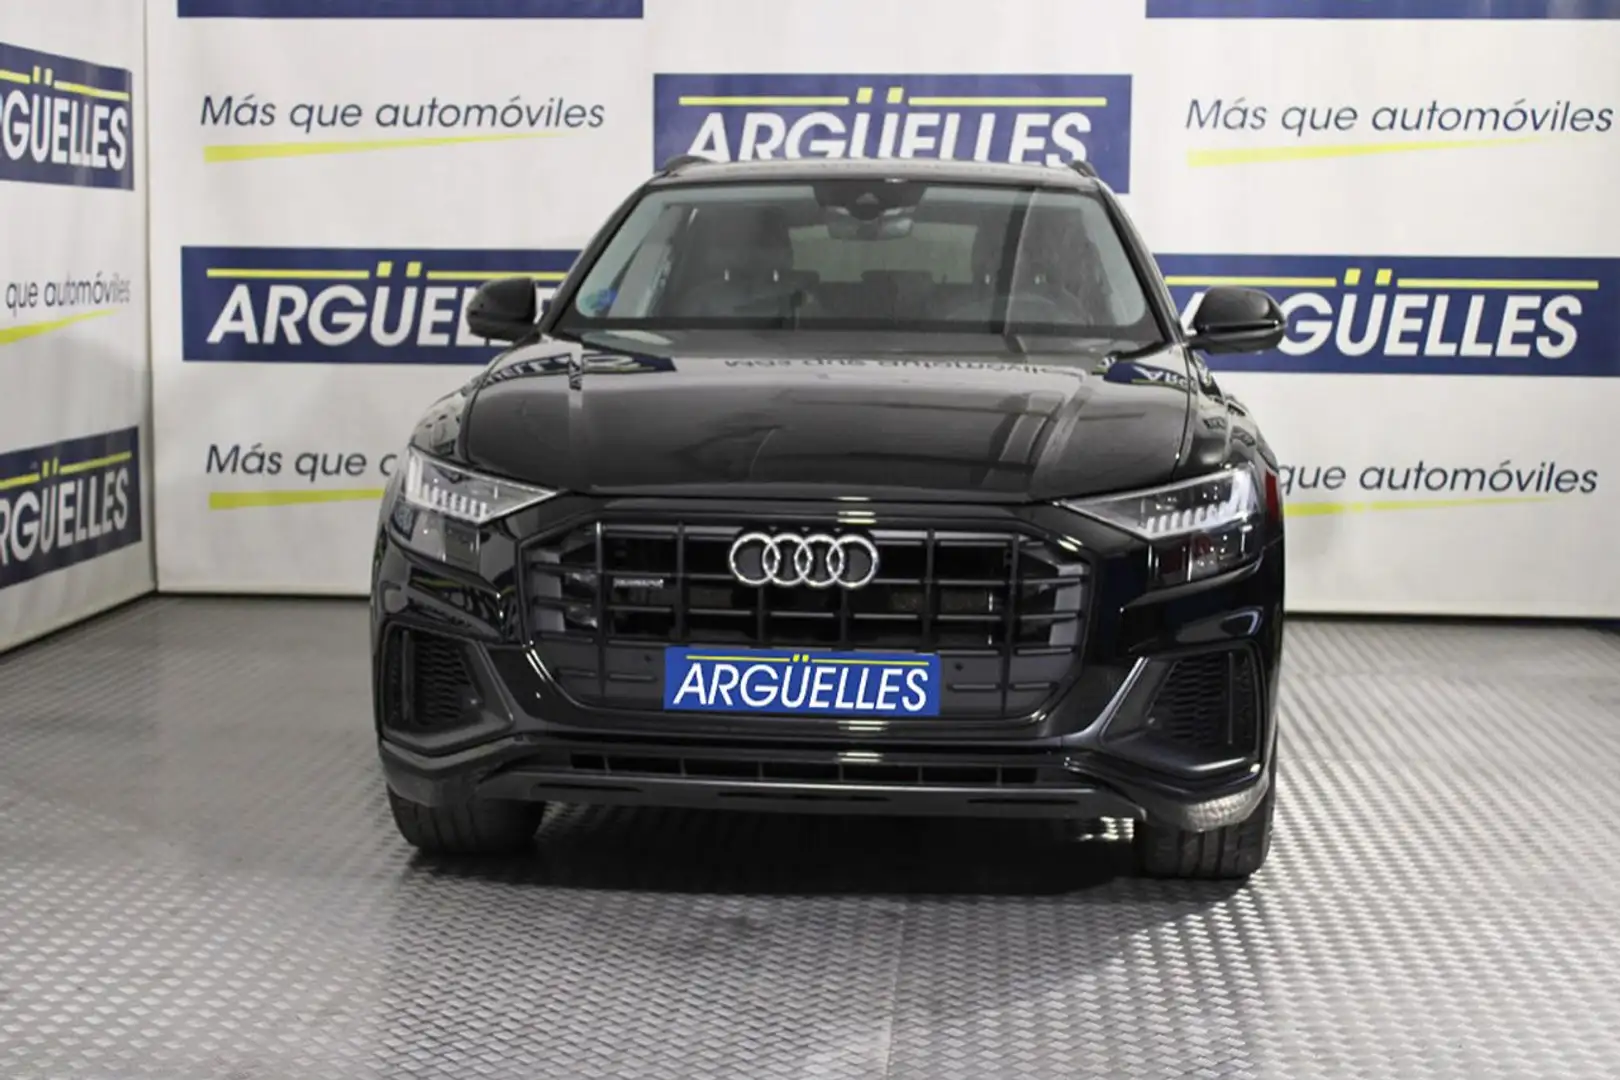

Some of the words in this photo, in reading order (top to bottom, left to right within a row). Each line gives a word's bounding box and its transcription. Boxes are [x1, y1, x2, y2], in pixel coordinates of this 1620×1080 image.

[0, 66, 128, 171] GÜELLES
[200, 94, 276, 127] Más
[289, 103, 363, 134] que
[375, 95, 605, 128] automóviles
[1186, 98, 1267, 131] Más
[1281, 106, 1358, 138] que
[1371, 99, 1614, 133] automóviles
[5, 282, 39, 318] que
[1180, 268, 1583, 359] GÜELLES
[205, 443, 283, 475] Más
[294, 452, 367, 483] que
[1279, 465, 1346, 496] que
[1358, 459, 1599, 495] automóviles
[673, 654, 929, 711] ARGÜELLES
